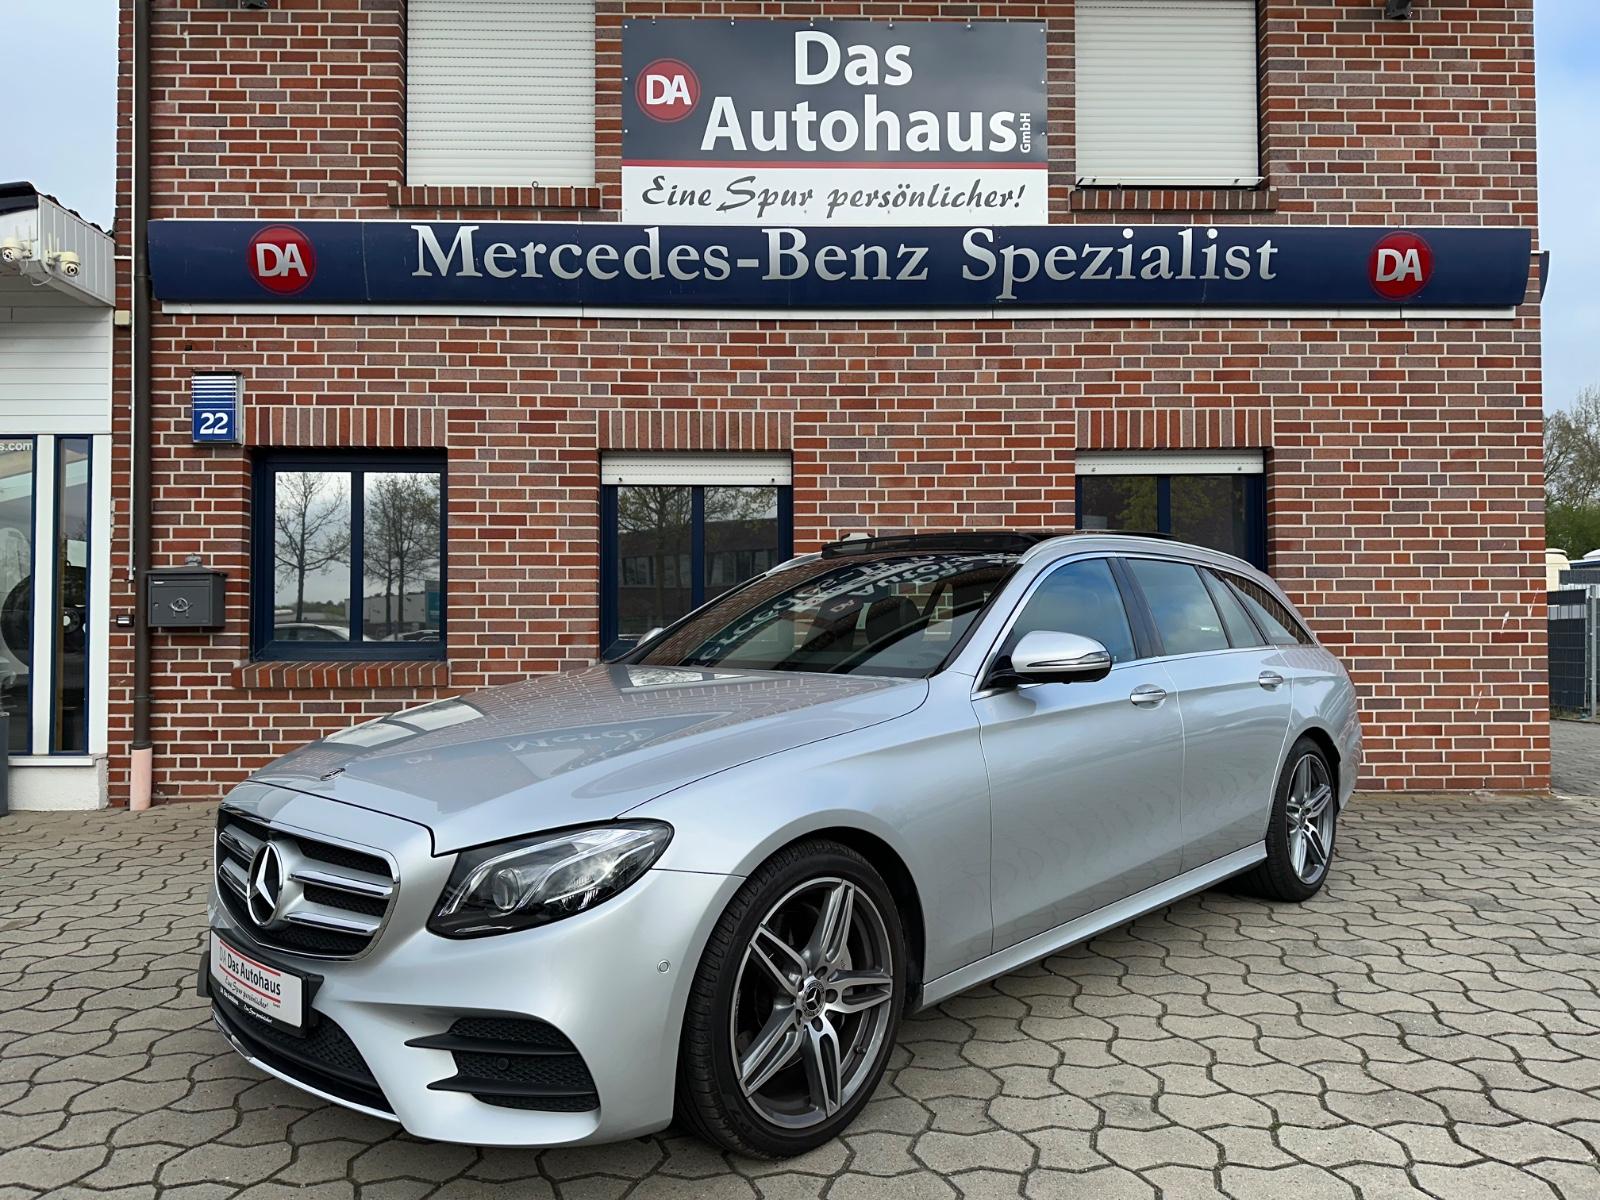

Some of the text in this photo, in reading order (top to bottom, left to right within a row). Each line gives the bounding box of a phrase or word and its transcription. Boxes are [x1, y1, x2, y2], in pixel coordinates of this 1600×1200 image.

[795, 30, 913, 86] Das
[646, 74, 692, 105] DA
[700, 94, 1017, 152] Autohaus
[1019, 112, 1031, 154] GmbH
[641, 175, 1026, 219] Eine Spur persönlicher!
[255, 242, 308, 278] DA
[410, 224, 1278, 301] Mercedes-Benz Spezialist
[1375, 247, 1424, 283] DA
[200, 412, 229, 435] 22
[227, 953, 239, 975] Das
[240, 962, 281, 996] Autohaus
